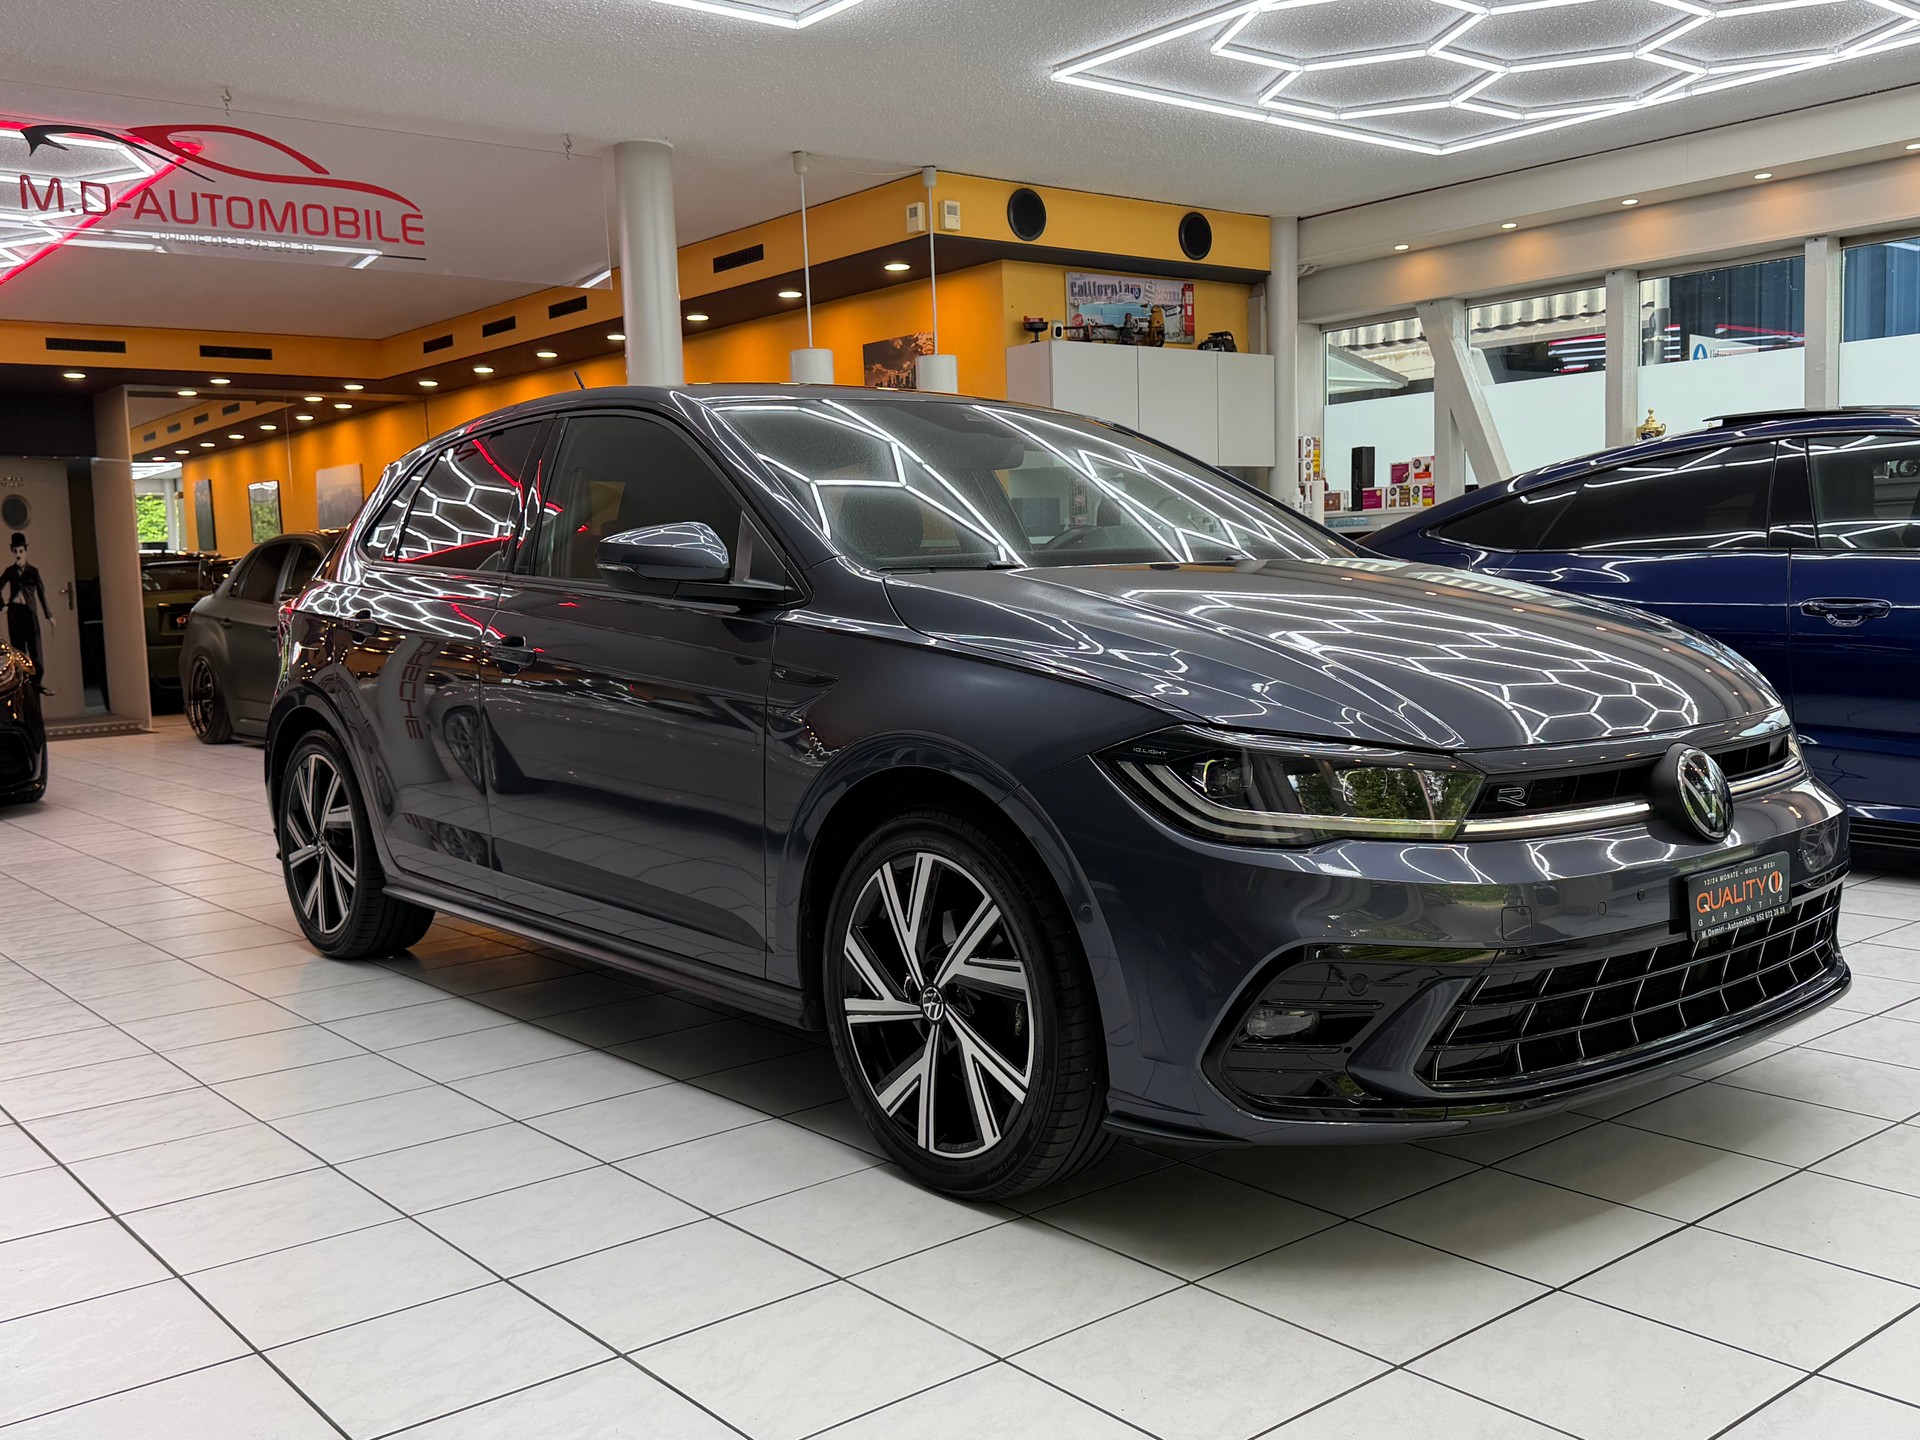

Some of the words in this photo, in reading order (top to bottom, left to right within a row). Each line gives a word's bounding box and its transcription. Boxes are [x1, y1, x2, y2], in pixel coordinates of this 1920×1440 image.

[20, 174, 426, 246] M.D-AUTOMOBILE
[1070, 281, 1130, 298] California
[1719, 871, 1739, 882] MONATE
[1697, 895, 1783, 927] GARANTIE
